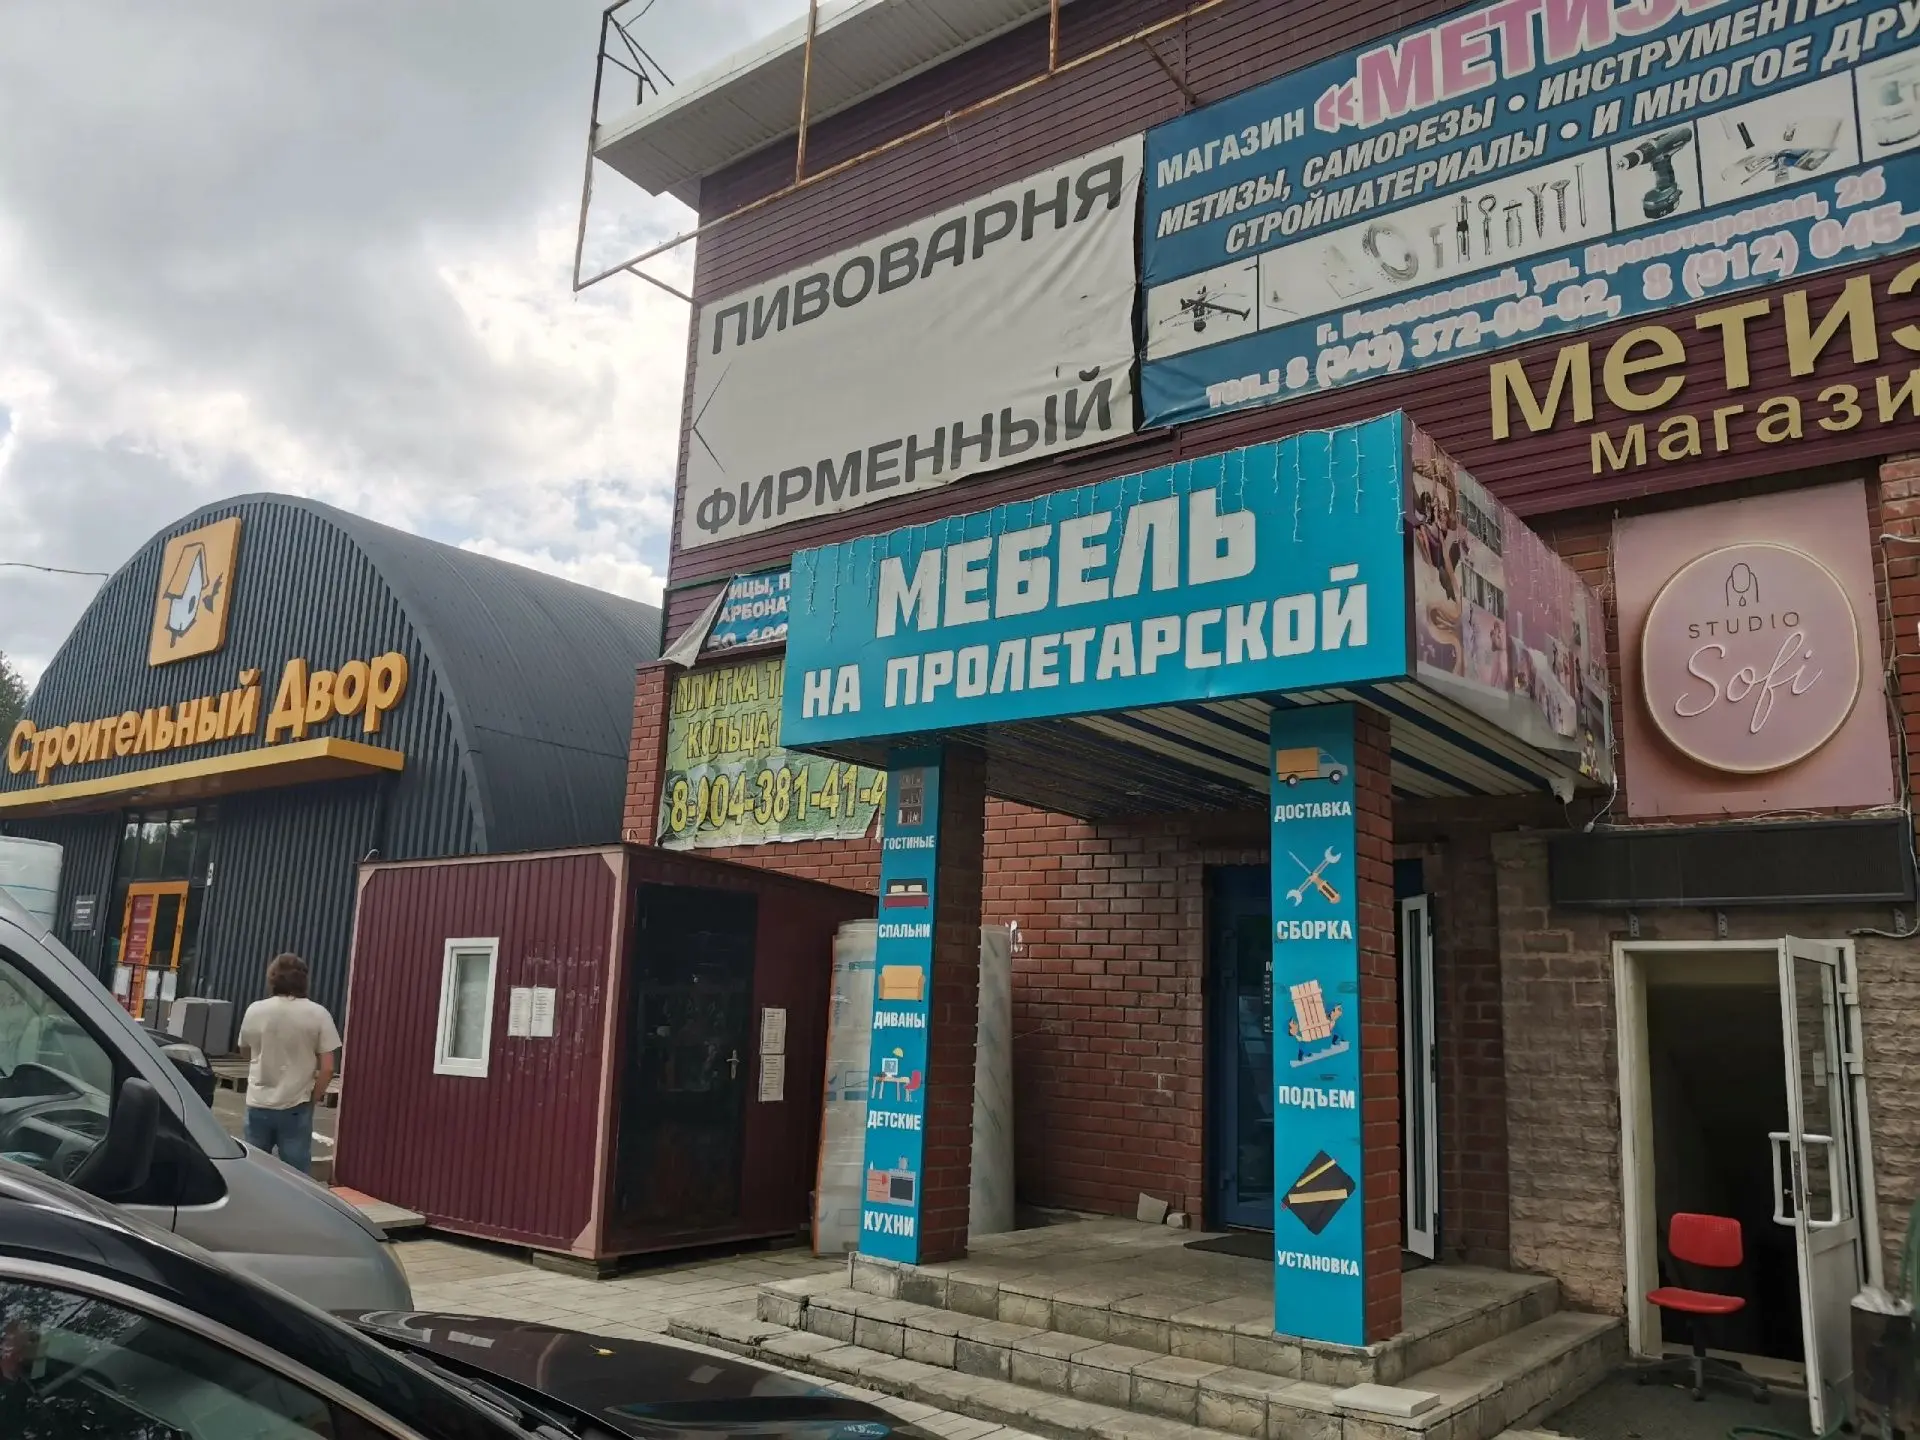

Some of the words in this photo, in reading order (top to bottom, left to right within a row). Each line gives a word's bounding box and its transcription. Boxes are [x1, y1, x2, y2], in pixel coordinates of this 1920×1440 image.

[1157, 108, 1304, 188] МАГАЗИН
[1314, 0, 1728, 132] «МЕТИ
[1157, 169, 1291, 239] МЕТИЗЫ,
[1303, 97, 1496, 188] САМОРЕЗЫ
[1226, 124, 1547, 254] СТРОЙМАТЕРИАЛЫ
[1592, 102, 1624, 138] И
[1633, 36, 1812, 127] МНОГОЕ
[712, 155, 1124, 355] ПИВОВАРНЯ
[1643, 262, 1673, 300] 8
[1682, 230, 1799, 299] (912)
[696, 365, 1113, 534] ФИРМЕННЫЙ
[875, 489, 1256, 638] МЕБЕЛЬ
[719, 595, 790, 622] АРБОНА
[1688, 611, 1799, 639] STUDIO
[801, 664, 861, 720] НА
[884, 562, 1368, 709] ПРОЛЕТАРСКОЙ
[675, 664, 759, 715] ПЛИТКА
[1674, 631, 1823, 734] Sofi
[8, 669, 261, 785] Строительный
[265, 651, 408, 744] Двор
[687, 710, 771, 759] КОЛЬЦА
[1274, 801, 1352, 822] ДОСТАВКА
[883, 835, 936, 850] ГОСТИНЫЕ
[878, 923, 931, 938] СПАЛЬНИ
[1276, 920, 1353, 940] СБОРКА
[873, 1010, 926, 1029] ДИВАНЫ
[867, 1110, 921, 1130] ДЕТСКИЕ
[1279, 1085, 1356, 1110] ПОДЪЕМ
[863, 1210, 915, 1237] КУХНИ
[1277, 1250, 1359, 1277] УСТАНОВКА
